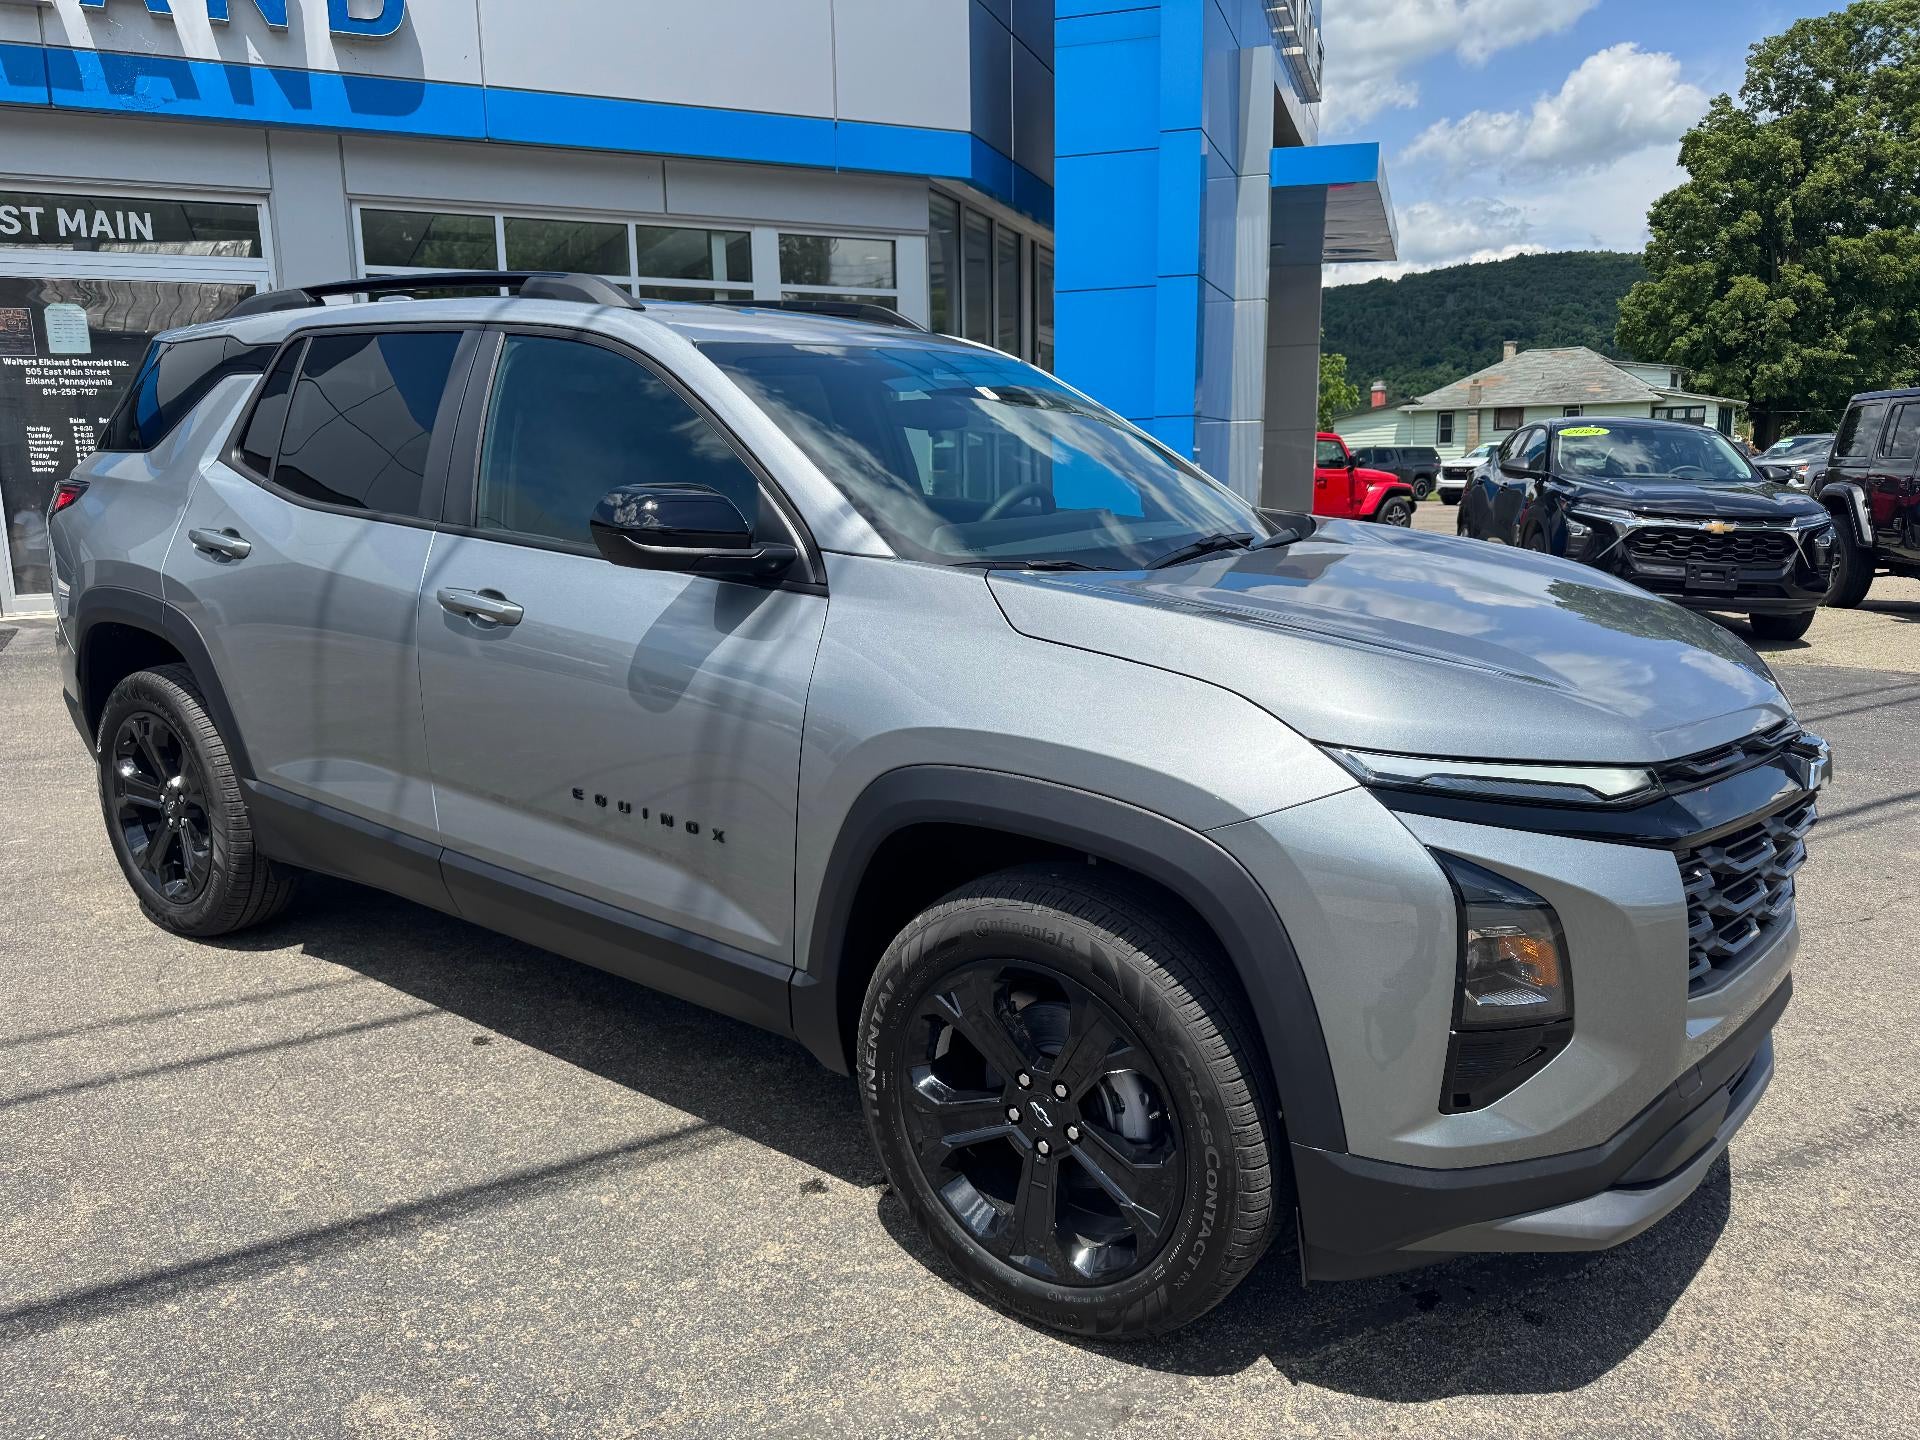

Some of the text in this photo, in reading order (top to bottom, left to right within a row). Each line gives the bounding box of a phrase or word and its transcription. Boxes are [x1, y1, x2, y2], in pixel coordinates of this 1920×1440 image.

[56, 207, 154, 241] MAIN
[3, 357, 130, 367] Walters Elkland Chevrolet Inc.
[25, 367, 110, 376] 505 East Main Street
[25, 377, 113, 387] Elkland, Pennsylvania
[42, 388, 98, 396] 814-258-7127
[572, 787, 725, 843] EQUINOX
